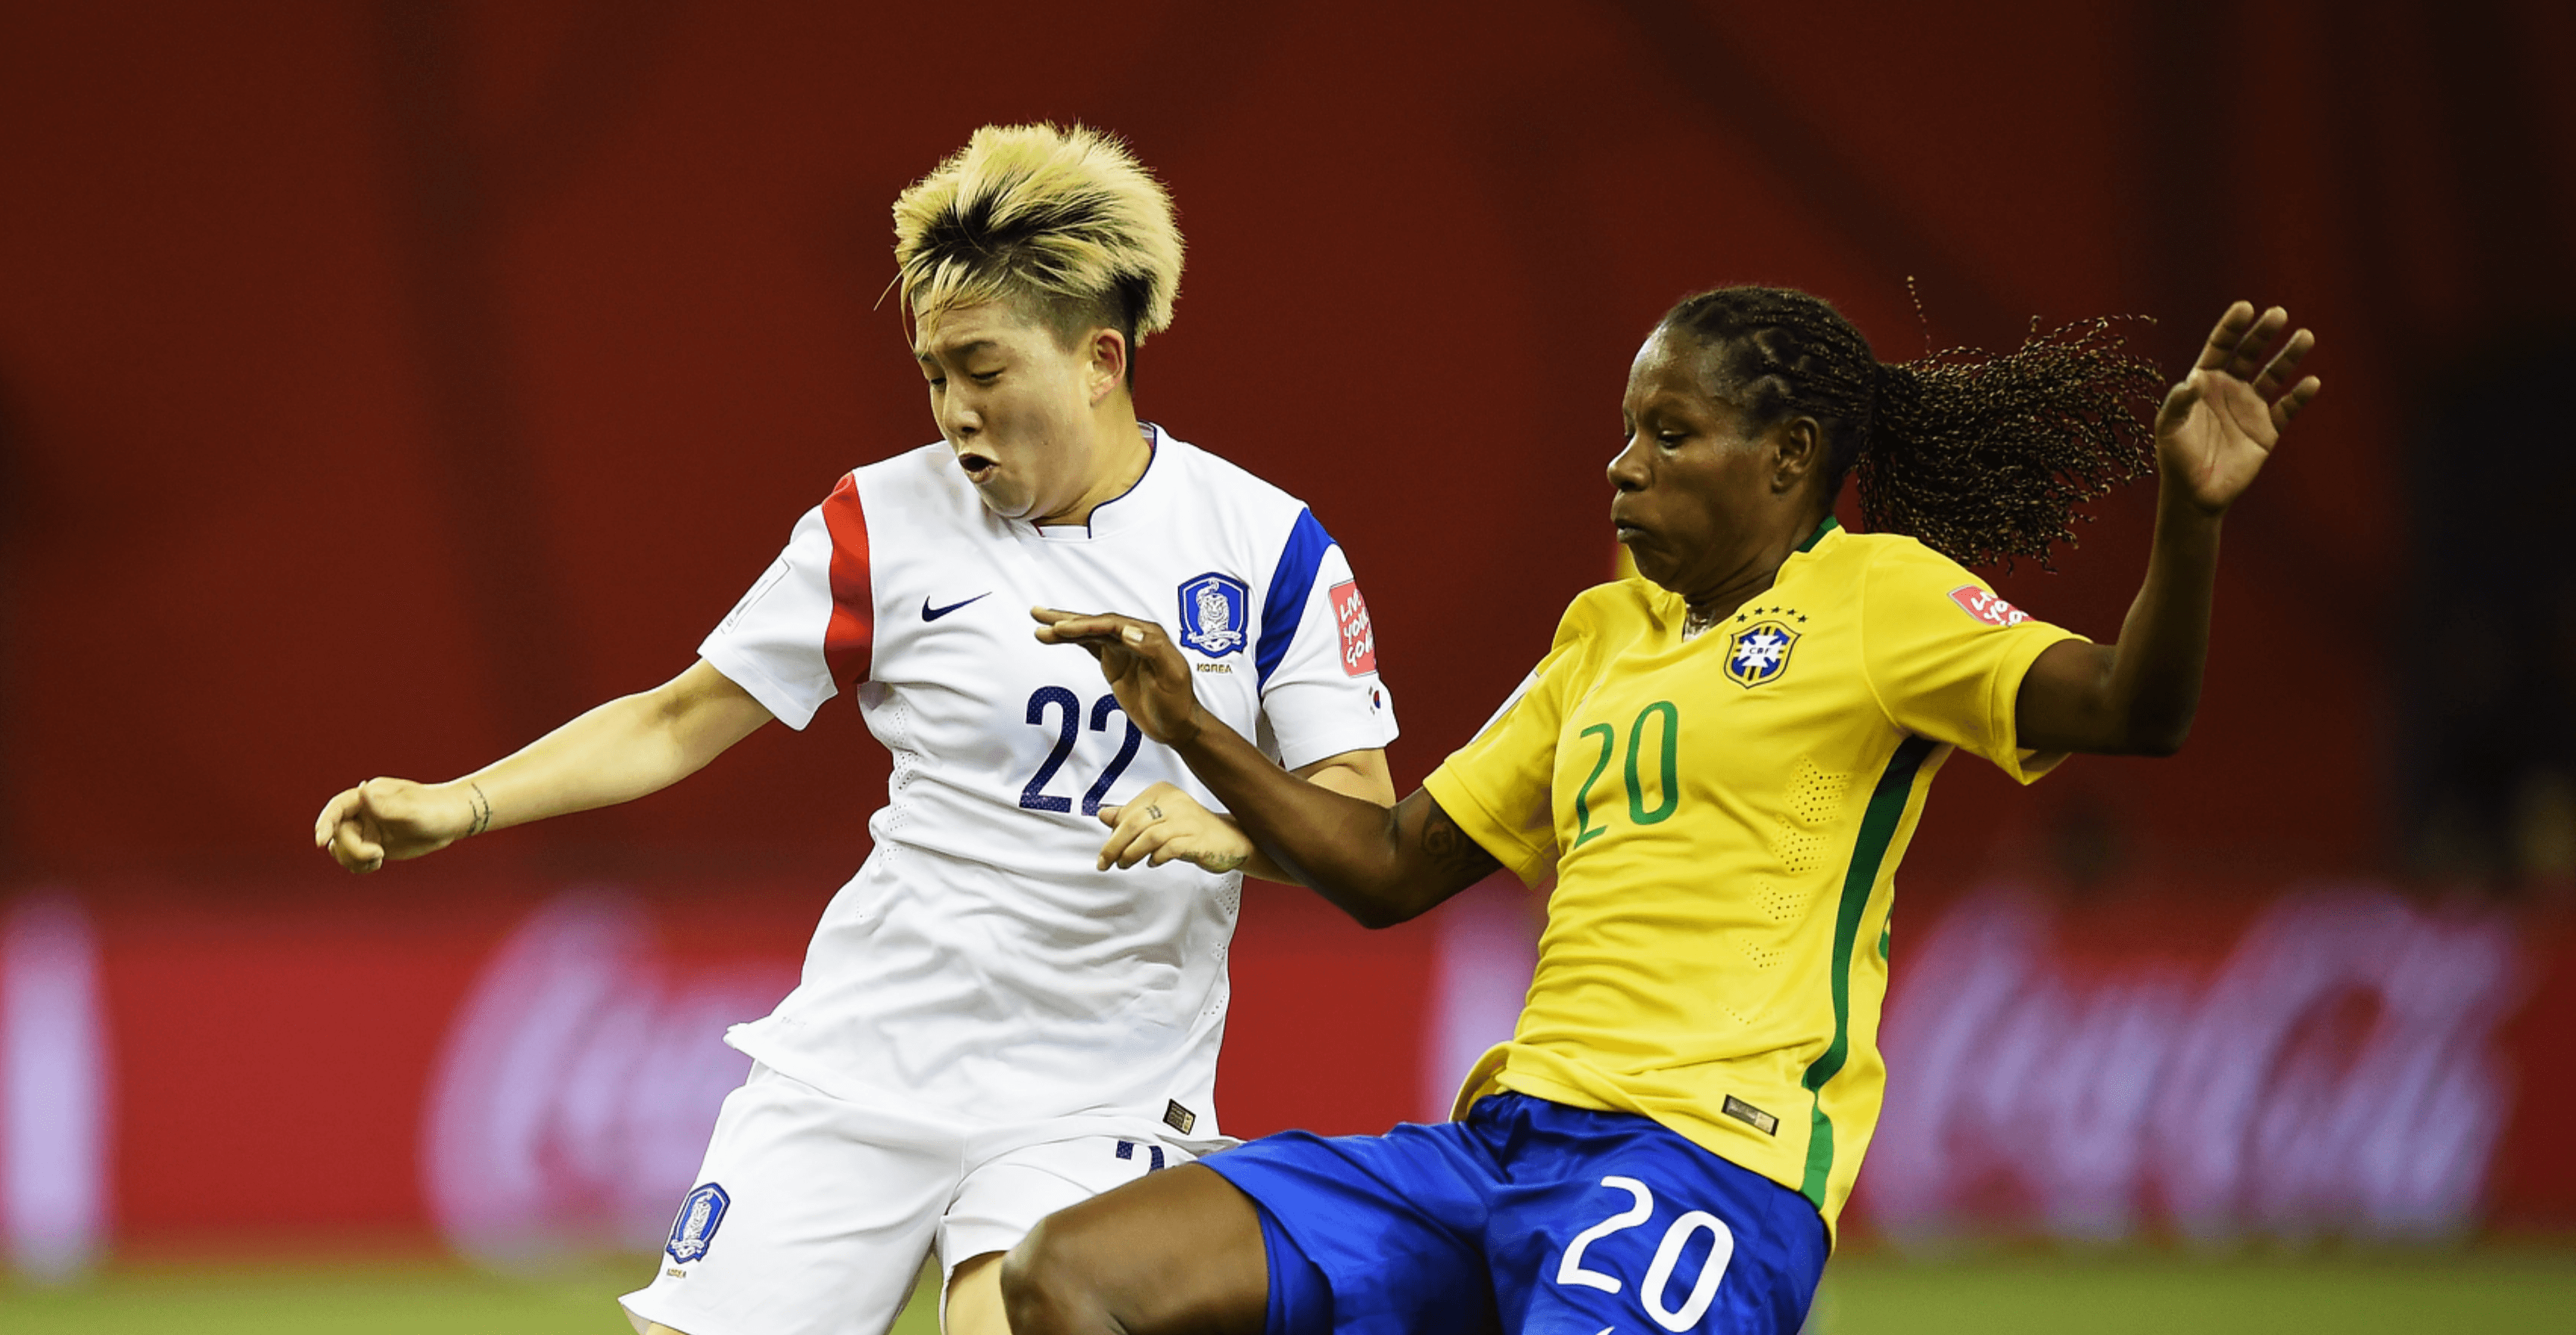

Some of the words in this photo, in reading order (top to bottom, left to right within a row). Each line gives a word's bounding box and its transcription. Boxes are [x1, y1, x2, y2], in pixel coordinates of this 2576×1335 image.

[1749, 646, 1772, 655] CBF
[1019, 686, 1142, 817] 22
[1574, 701, 1678, 850] 20
[1557, 1175, 1734, 1332] 20
